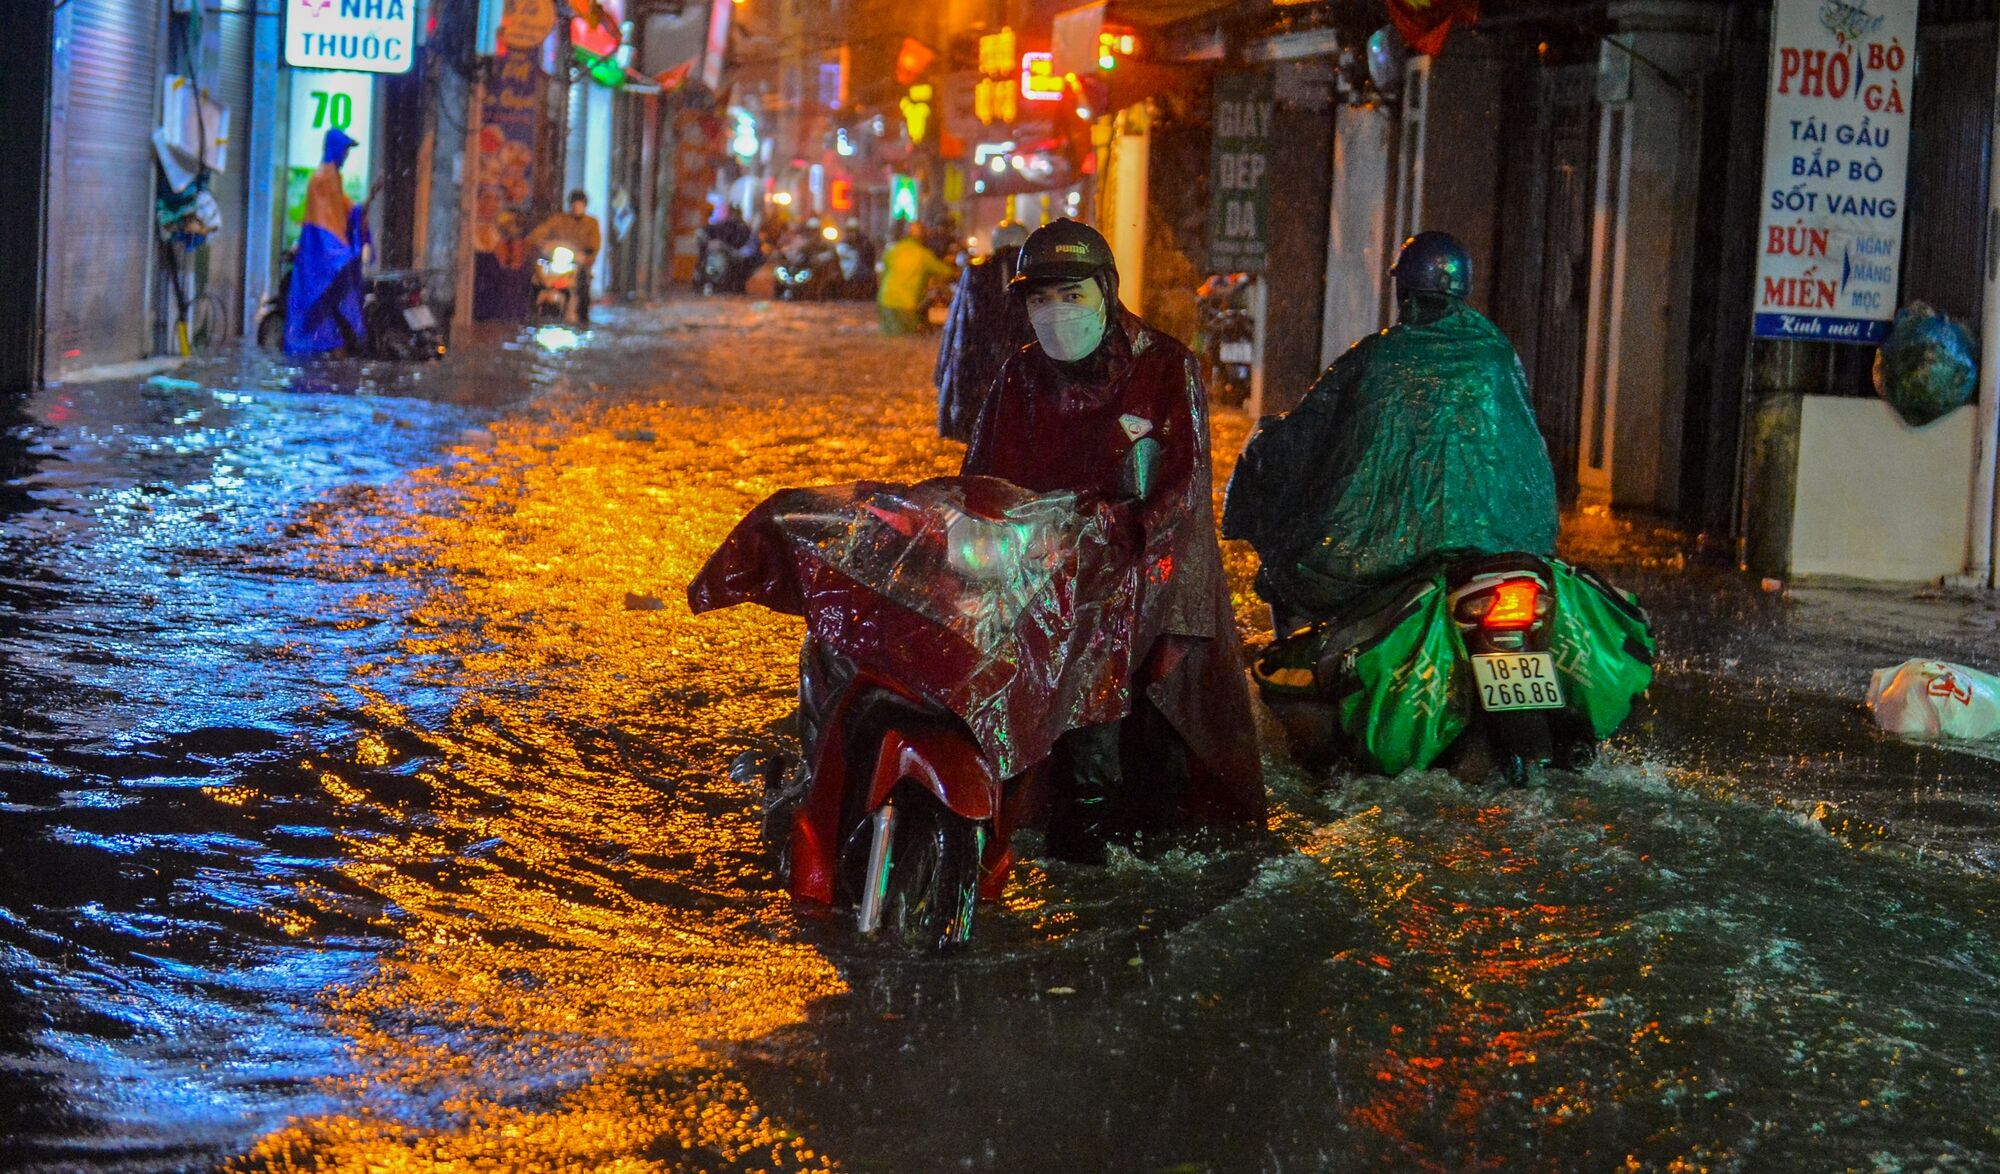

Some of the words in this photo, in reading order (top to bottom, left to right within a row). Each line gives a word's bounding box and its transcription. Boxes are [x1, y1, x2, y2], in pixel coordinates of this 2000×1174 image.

[301, 29, 401, 61] THUỐC
[1867, 36, 1905, 72] BÒ
[1778, 31, 1852, 99] PHỞ
[310, 91, 352, 131] 70
[1864, 79, 1904, 114] GÀ
[1790, 115, 1827, 143] TÁI
[1836, 115, 1889, 148] GẦU
[1792, 147, 1840, 178] BẮP
[1849, 156, 1883, 182] BÒ
[1771, 182, 1818, 212] SỐT
[1827, 194, 1897, 218] VANG
[1055, 244, 1086, 254] PUMA
[1766, 218, 1830, 258] BÚN
[1855, 236, 1892, 256] NGAN
[1762, 265, 1837, 310] MIẾN
[1851, 291, 1881, 312] MỌC
[1828, 321, 1860, 337] mời
[1867, 321, 1875, 338] !
[1487, 657, 1544, 680] 18-B2
[1484, 681, 1558, 706] 266.86
